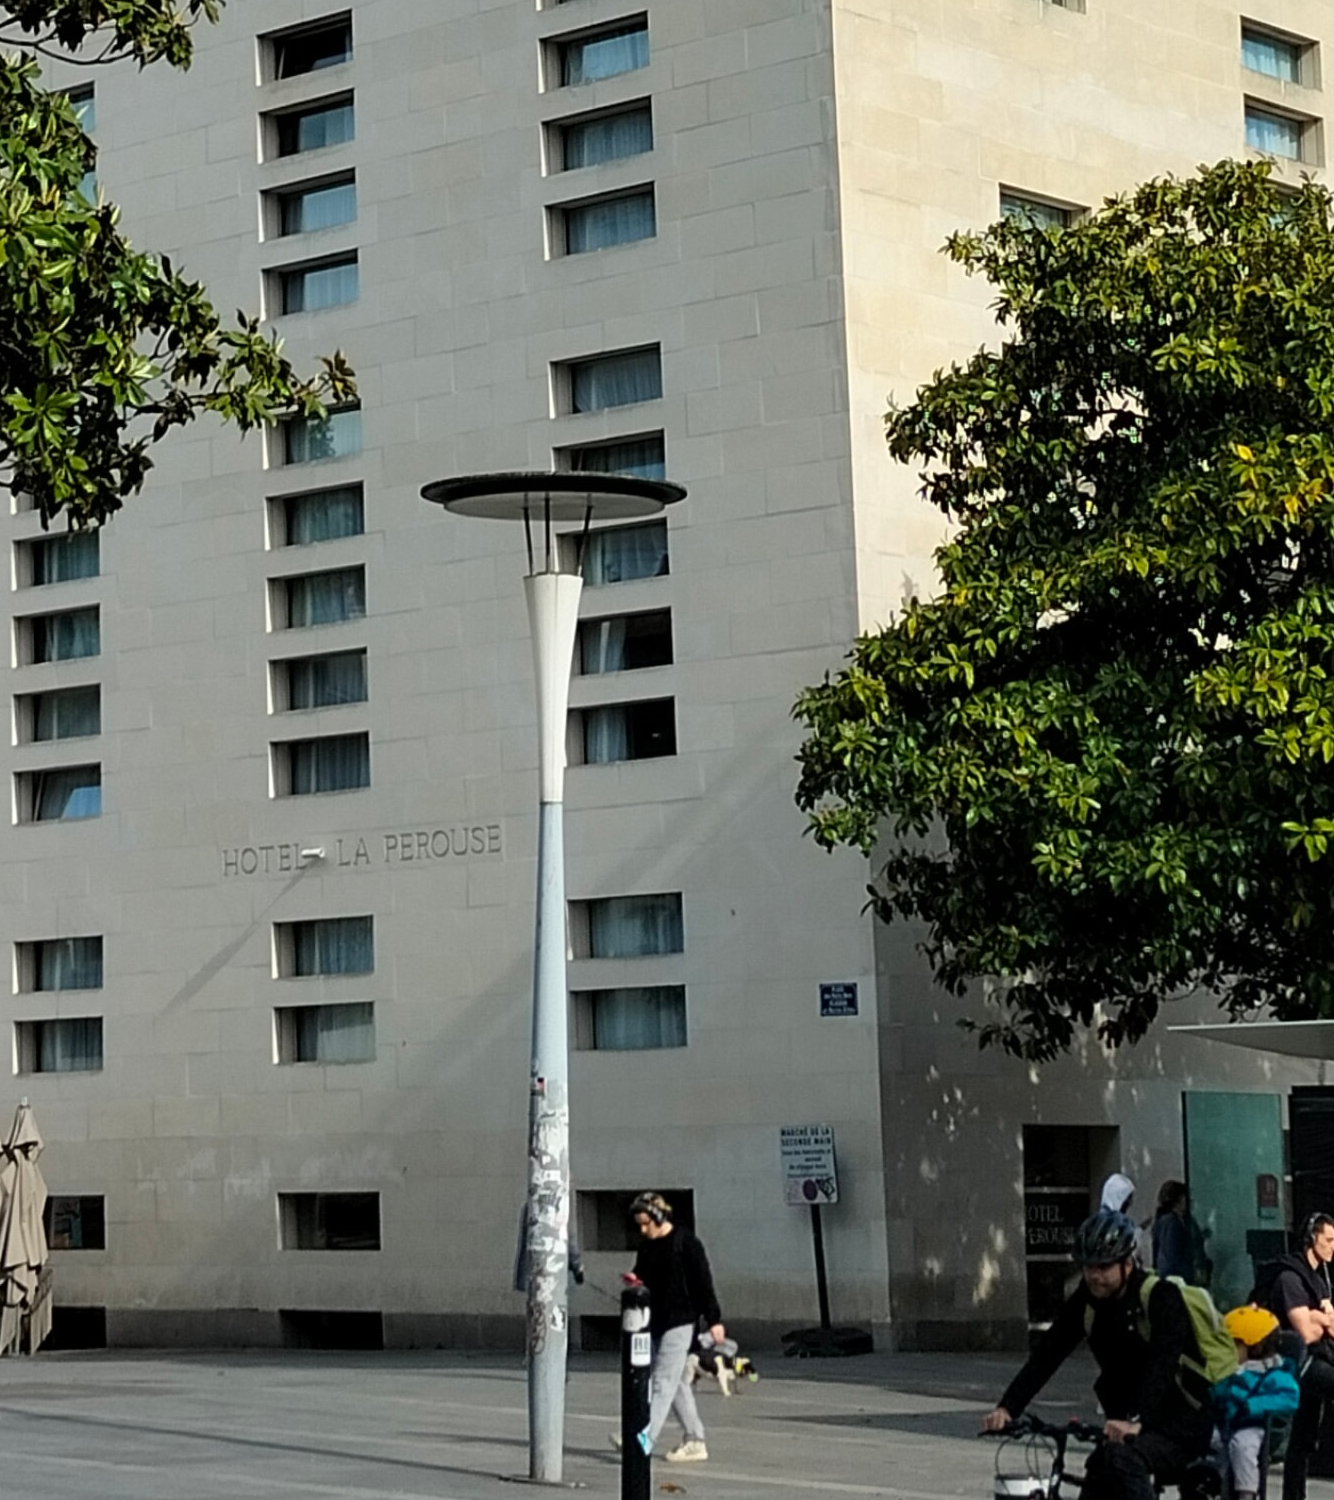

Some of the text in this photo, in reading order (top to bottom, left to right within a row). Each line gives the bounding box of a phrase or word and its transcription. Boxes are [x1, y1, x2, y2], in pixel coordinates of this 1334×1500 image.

[223, 825, 502, 877] HOTEL LA PEROUSE
[810, 1127, 819, 1136] DE
[821, 1128, 830, 1136] LA
[1027, 1204, 1065, 1222] OTEL
